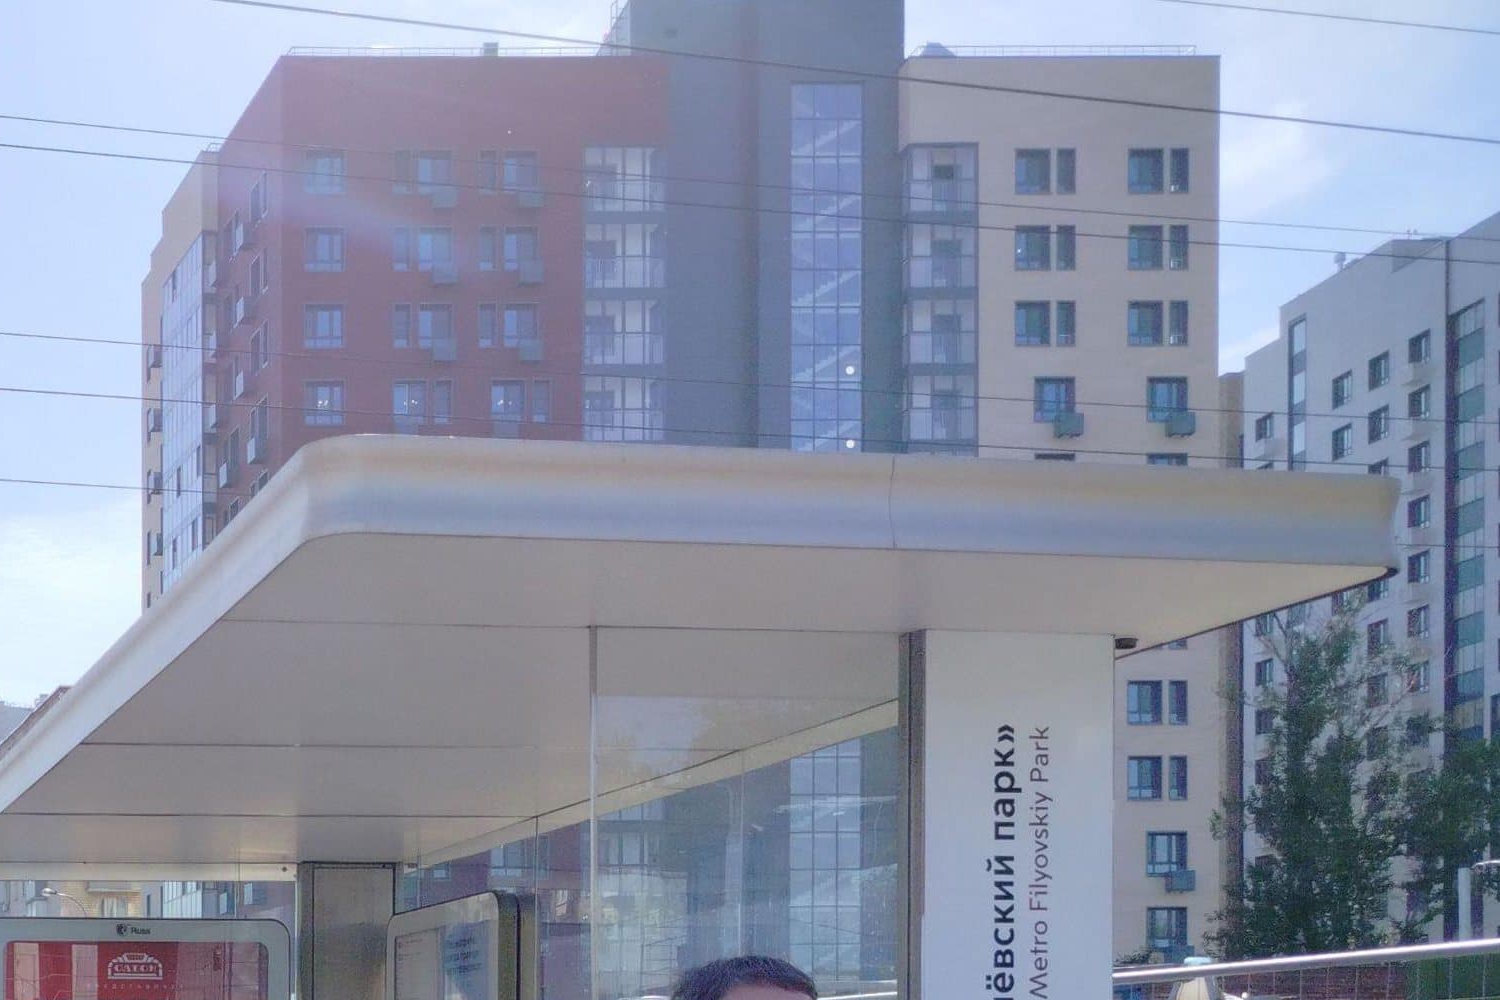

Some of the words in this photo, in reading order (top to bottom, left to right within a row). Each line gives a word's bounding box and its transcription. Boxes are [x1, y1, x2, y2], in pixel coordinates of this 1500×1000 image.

[993, 723, 1022, 841] парк»
[1028, 725, 1050, 783] Park
[1028, 791, 1054, 912] Filyovskiy
[1028, 920, 1049, 1000] Metro
